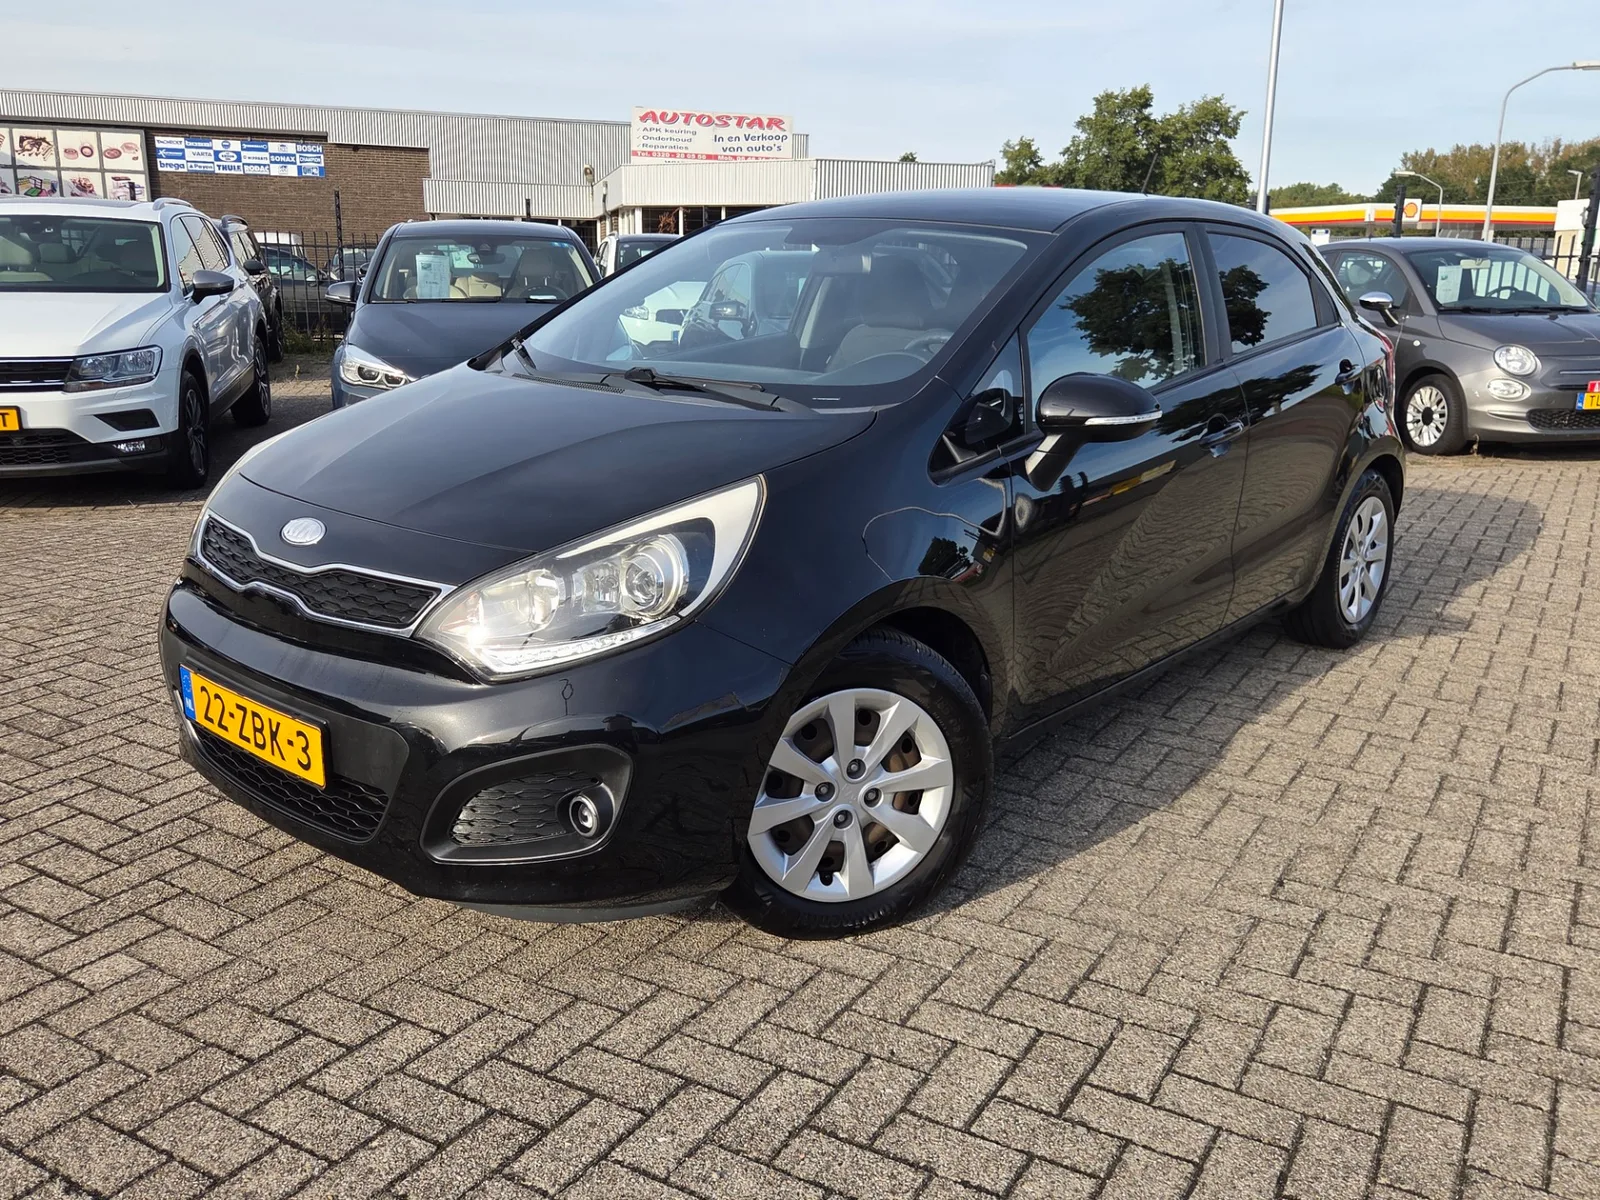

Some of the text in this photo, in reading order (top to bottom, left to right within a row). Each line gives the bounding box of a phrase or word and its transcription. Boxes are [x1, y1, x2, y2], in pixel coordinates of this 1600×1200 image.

[639, 110, 786, 131] AUTOSTAR
[665, 128, 697, 136] keuring
[642, 135, 692, 143] Onderhoud
[714, 134, 724, 142] In
[744, 133, 788, 142] Verkoop
[296, 144, 322, 153] BOSCH
[747, 144, 782, 152] auto's
[270, 155, 296, 163] SONAX
[159, 160, 185, 170] brega
[216, 164, 242, 172] THULE
[244, 164, 270, 172] RODAC
[185, 697, 195, 711] NL
[200, 685, 312, 771] 22-ZBK-3
